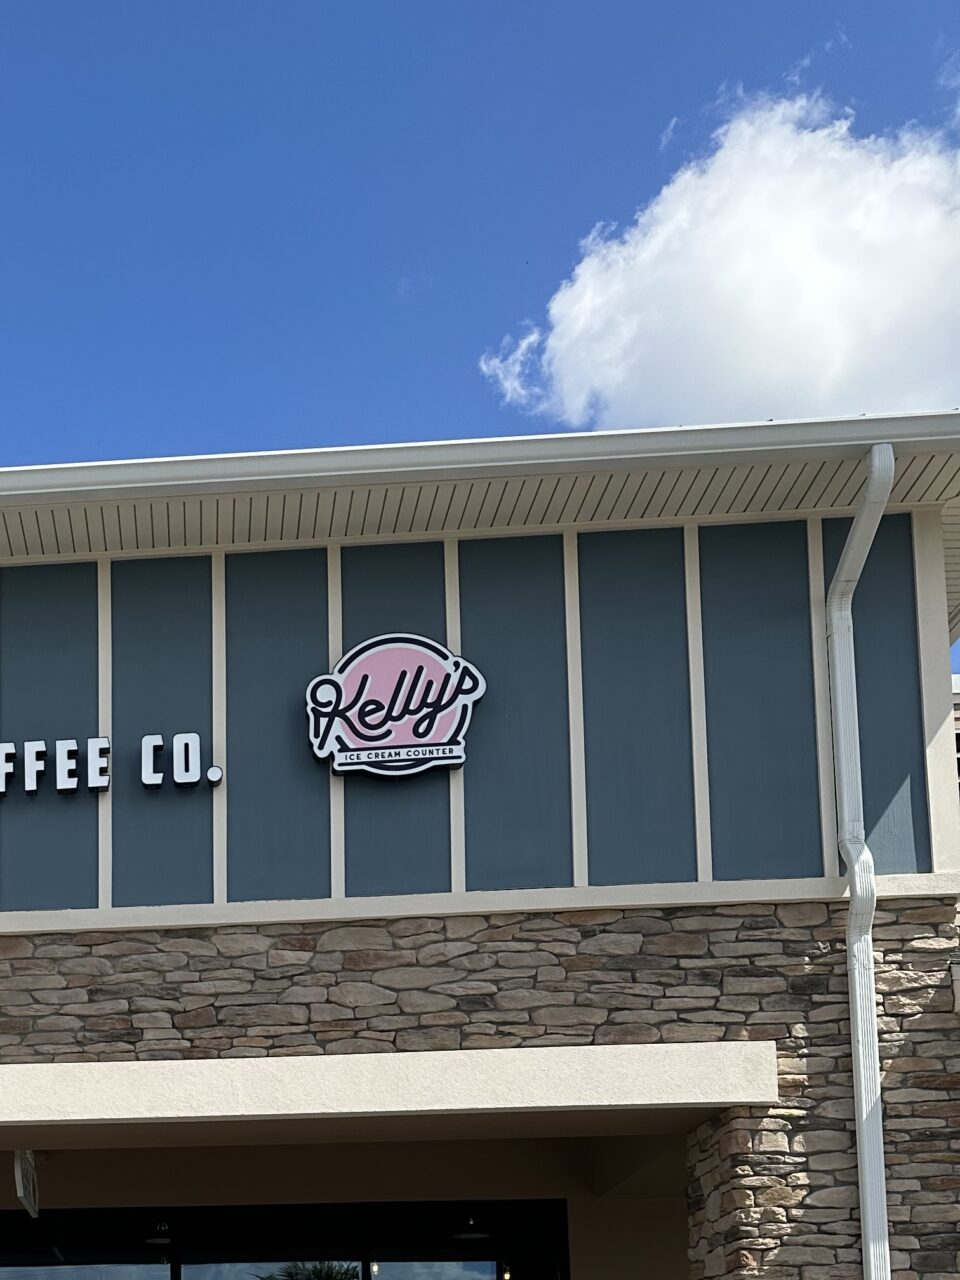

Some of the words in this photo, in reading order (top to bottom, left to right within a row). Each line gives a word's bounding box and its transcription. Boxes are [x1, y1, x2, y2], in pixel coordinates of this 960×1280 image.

[310, 660, 479, 750] Kelly's
[141, 732, 224, 790] CO.
[344, 753, 362, 761] ICE
[366, 751, 401, 760] CREAM
[406, 747, 455, 758] COUNTER
